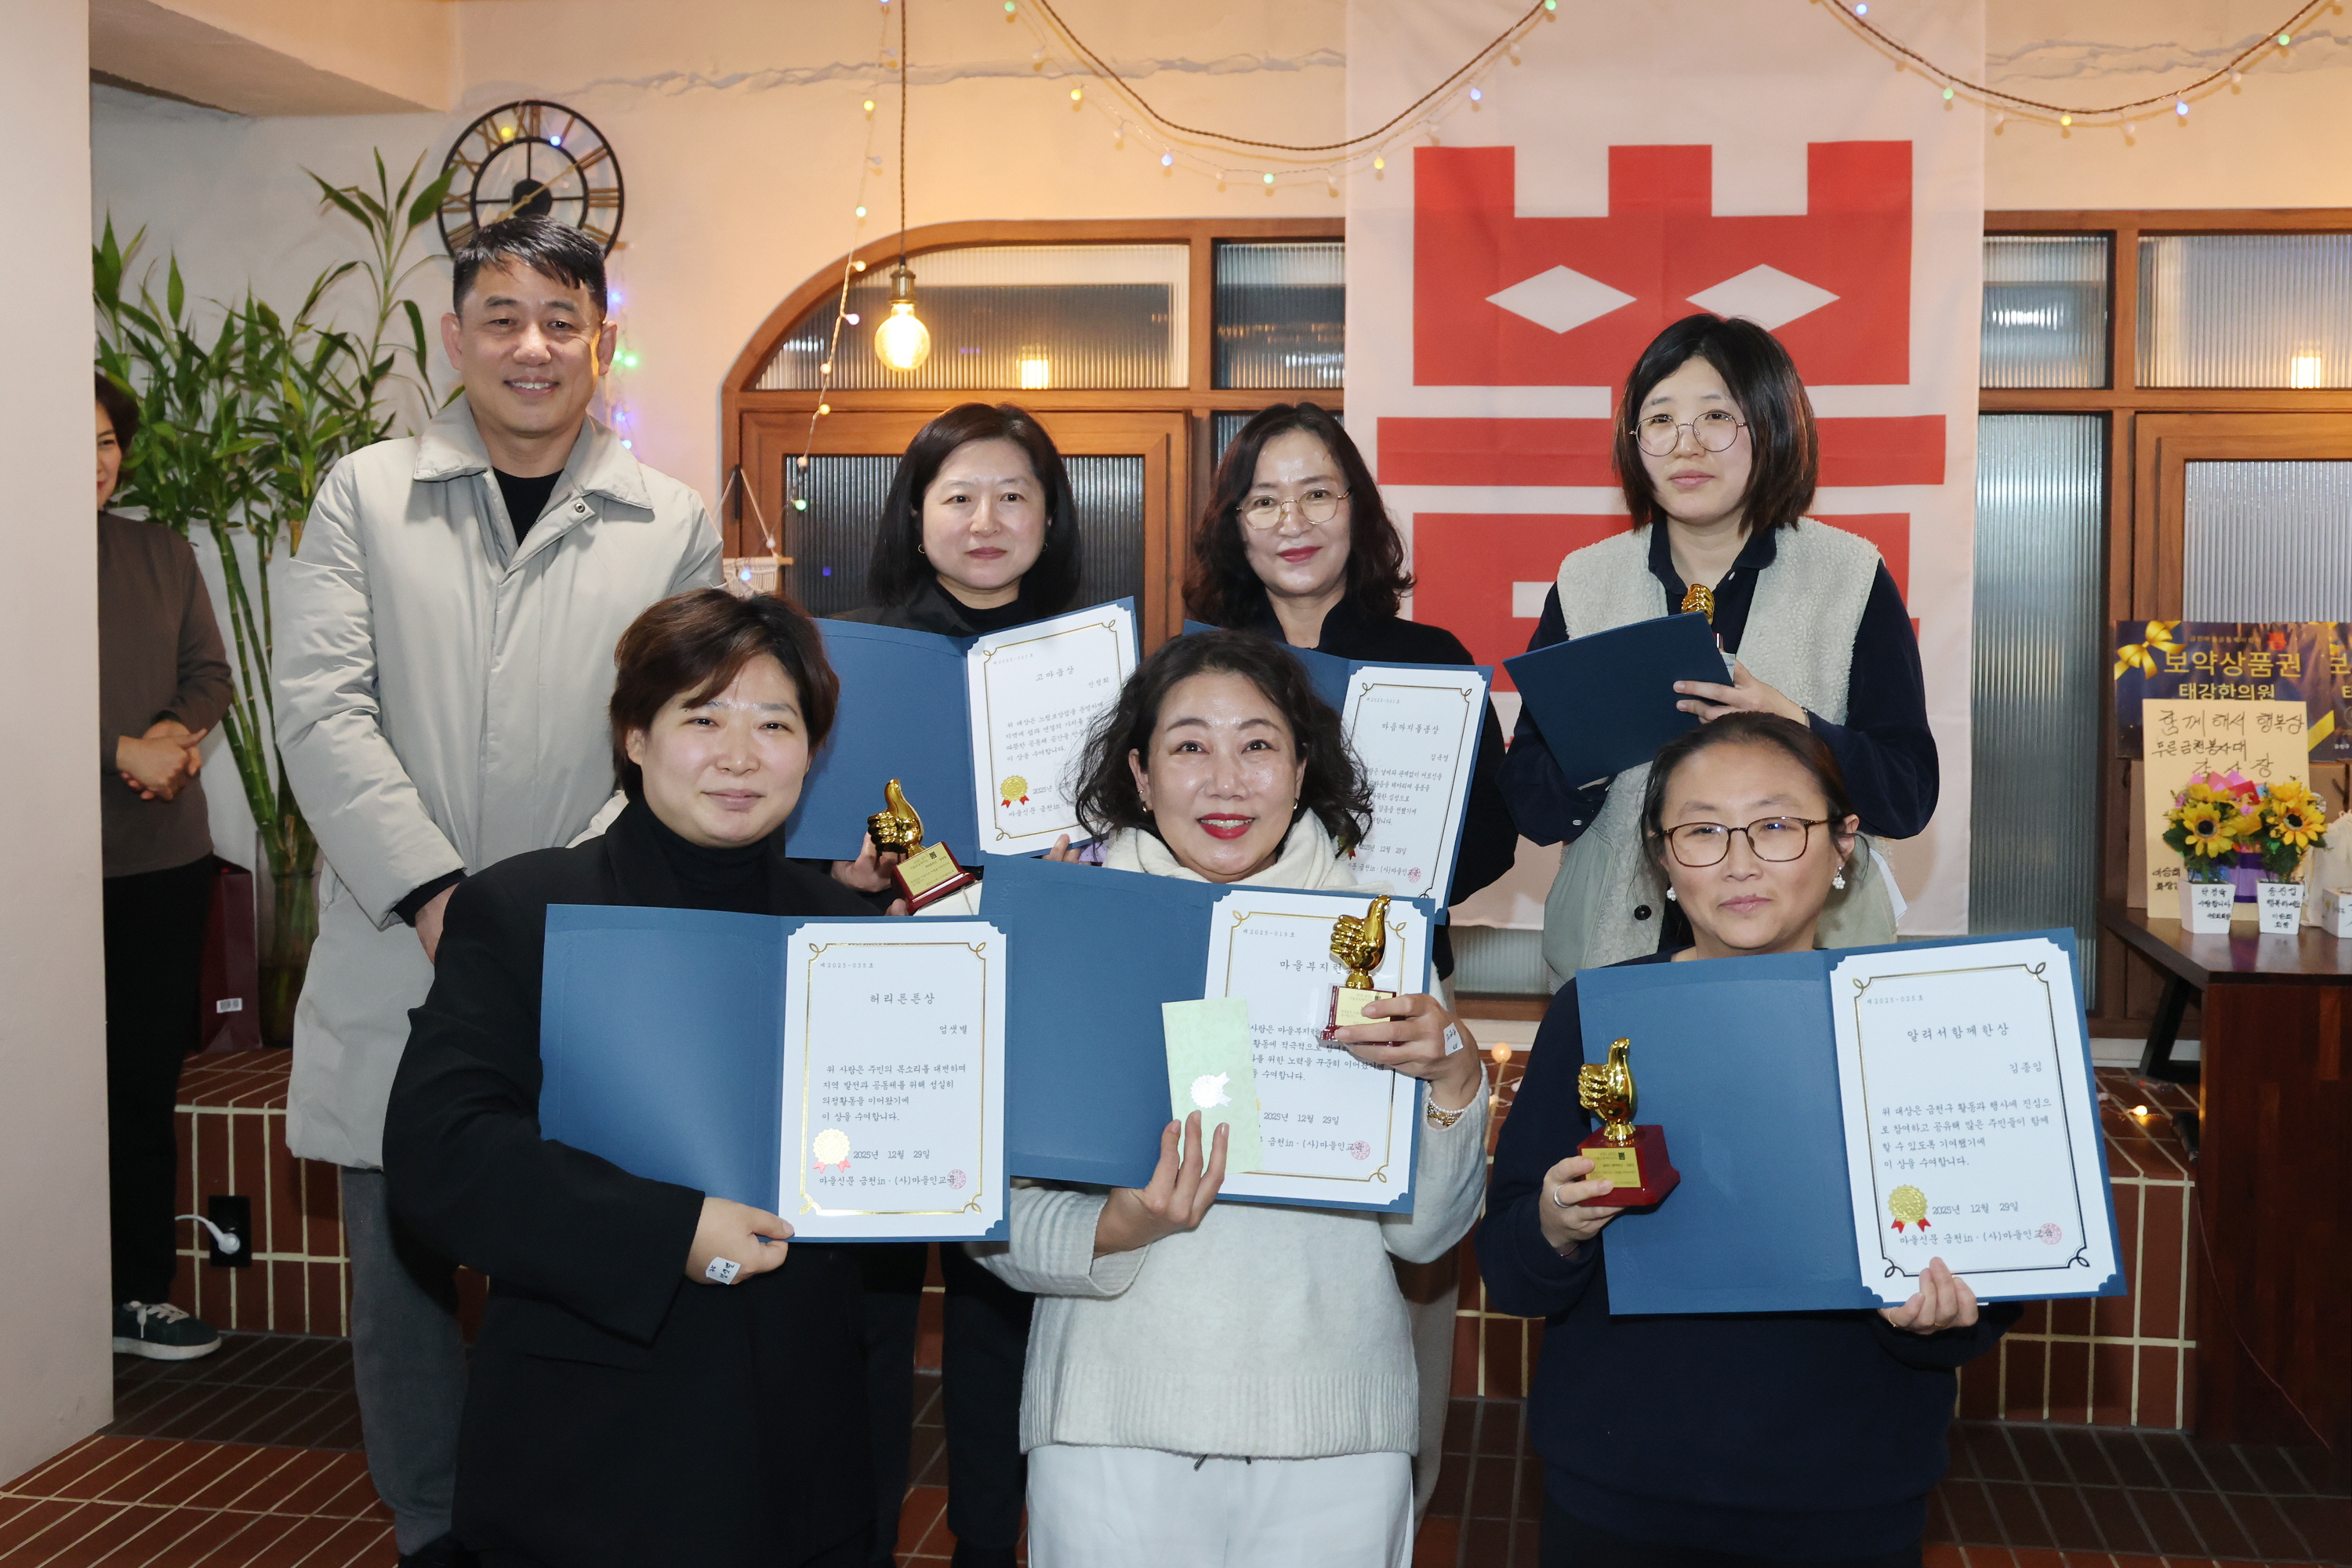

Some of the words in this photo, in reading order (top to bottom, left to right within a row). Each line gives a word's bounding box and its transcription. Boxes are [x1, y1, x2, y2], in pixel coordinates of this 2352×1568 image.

[2164, 651, 2302, 677] 보약상품권
[1036, 666, 1074, 681] 고마움상
[2179, 683, 2275, 699] 태강한의원
[1016, 717, 1036, 726] 대상은
[2159, 710, 2206, 737] 함께
[2212, 711, 2245, 735] 해서
[2256, 713, 2304, 735] 행복상
[1421, 771, 1443, 780] 어르신을
[1033, 786, 1052, 794] 2025년
[1009, 808, 1035, 817] 마을신문
[870, 993, 935, 1005] 허리튼튼상
[1250, 1024, 1274, 1033] 사람은
[1907, 1022, 2009, 1043] 알려서함께한상
[1253, 1040, 1276, 1049] 활동에
[1281, 1041, 1322, 1051] 적극적으로
[1269, 1055, 1284, 1065] 위한
[1287, 1057, 1312, 1066] 노력을
[1316, 1058, 1340, 1068] 꾸준히
[827, 1065, 834, 1074] 위
[840, 1065, 864, 1074] 사람은
[868, 1065, 892, 1074] 주민의
[897, 1065, 930, 1074] 목소리를
[934, 1064, 966, 1073] 대변하며
[1261, 1070, 1305, 1080] 수여합니다.
[822, 1081, 839, 1090] 지역
[844, 1081, 869, 1091] 발전과
[873, 1080, 905, 1091] 공동체를
[909, 1080, 925, 1089] 위해
[930, 1080, 954, 1089] 성실히
[822, 1097, 864, 1106] 의정활동을
[868, 1096, 909, 1105] 이어왔기에
[1882, 1108, 1890, 1117] 위
[1896, 1105, 1922, 1117] 대상은
[1926, 1103, 1954, 1115] 금천구
[1958, 1102, 1986, 1113] 활동과
[1990, 1099, 2017, 1111] 행사에
[2023, 1098, 2052, 1109] 진심으
[822, 1112, 829, 1121] 이
[834, 1112, 851, 1122] 상을
[855, 1112, 900, 1122] 수여합니다.
[1264, 1112, 1288, 1122] 2025년
[1298, 1115, 1314, 1123] 12월
[1323, 1116, 1339, 1125] 29일
[1881, 1126, 1889, 1134] 로
[1893, 1123, 1929, 1134] 참여하고
[1933, 1120, 1960, 1133] 공유해
[1965, 1119, 1984, 1131] 많은
[1988, 1117, 2025, 1129] 주민들이
[2031, 1116, 2049, 1127] 함께
[1268, 1138, 1294, 1147] 금천in
[1882, 1142, 1891, 1153] 할
[1895, 1142, 1904, 1151] 수
[1908, 1139, 1935, 1152] 있도록
[1940, 1137, 1986, 1149] 기여했기에
[853, 1150, 879, 1160] 2025년
[887, 1149, 904, 1160] 12월
[913, 1149, 930, 1159] 29일
[1885, 1160, 1892, 1169] 이
[1897, 1158, 1915, 1170] 상을
[1919, 1156, 1969, 1168] 수여합니다.
[819, 1176, 855, 1186] 마을신문
[859, 1176, 886, 1185] 금천in
[1932, 1204, 1960, 1215] 2025년
[1970, 1203, 1989, 1214] 12월
[2000, 1201, 2018, 1212] 29일
[1900, 1232, 1938, 1246] 마을신문
[1944, 1233, 1973, 1244] 금천in
